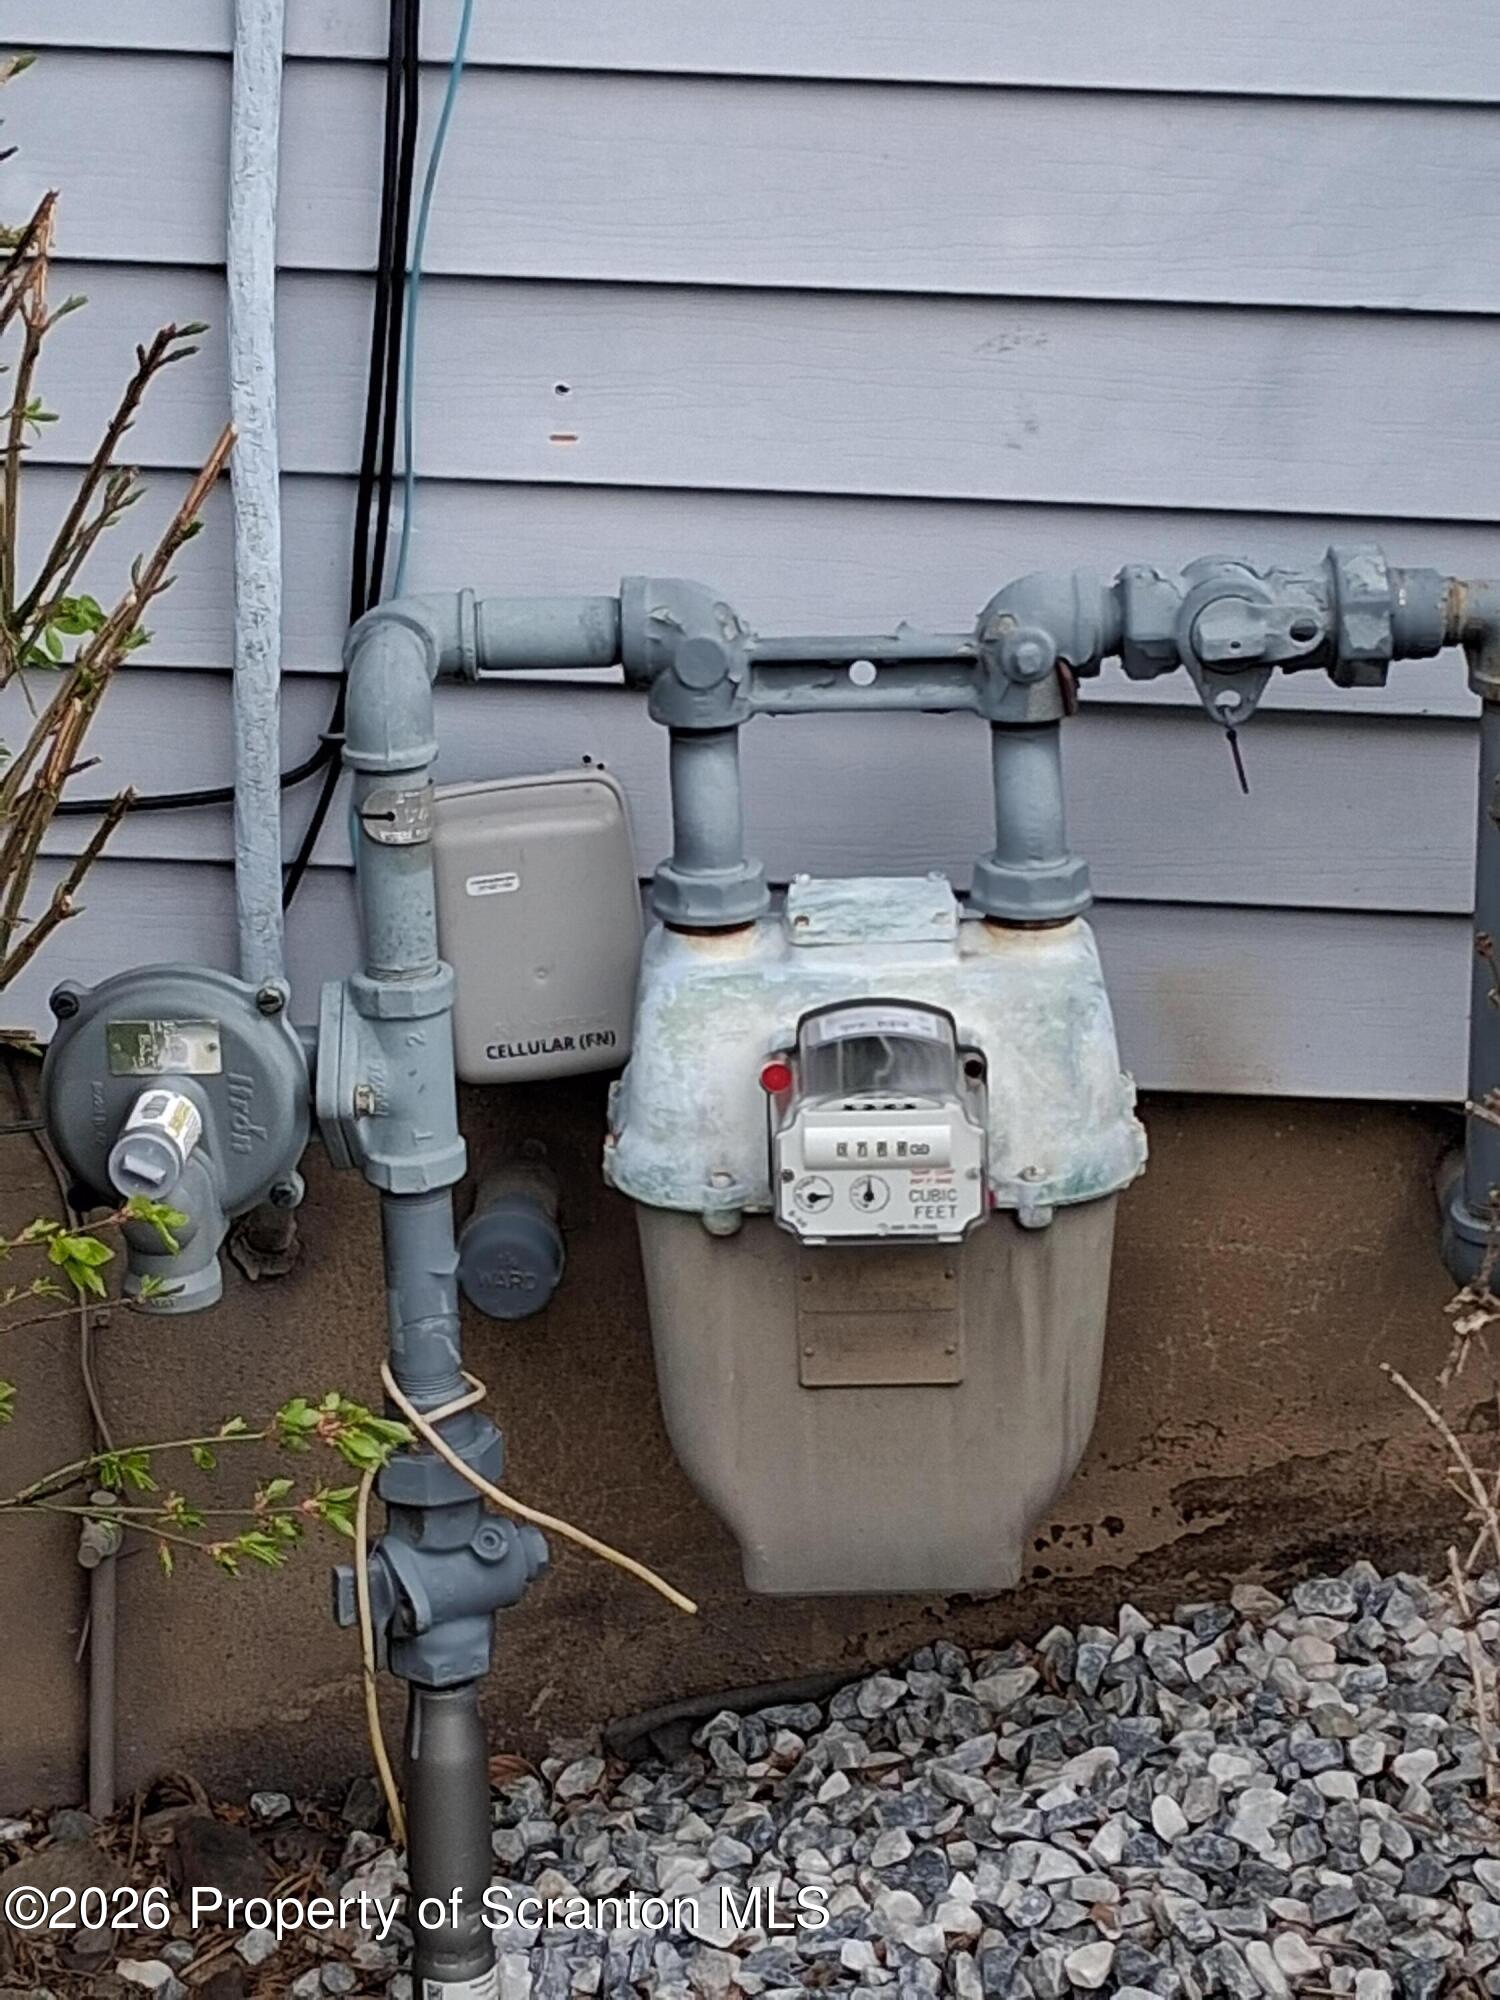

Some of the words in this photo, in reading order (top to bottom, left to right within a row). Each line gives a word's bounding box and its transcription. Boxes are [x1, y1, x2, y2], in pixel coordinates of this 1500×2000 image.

[486, 1036, 576, 1060] CELLULAR
[579, 1030, 616, 1051] (FN)
[909, 1188, 957, 1203] CUBIC
[914, 1204, 958, 1219] FEET
